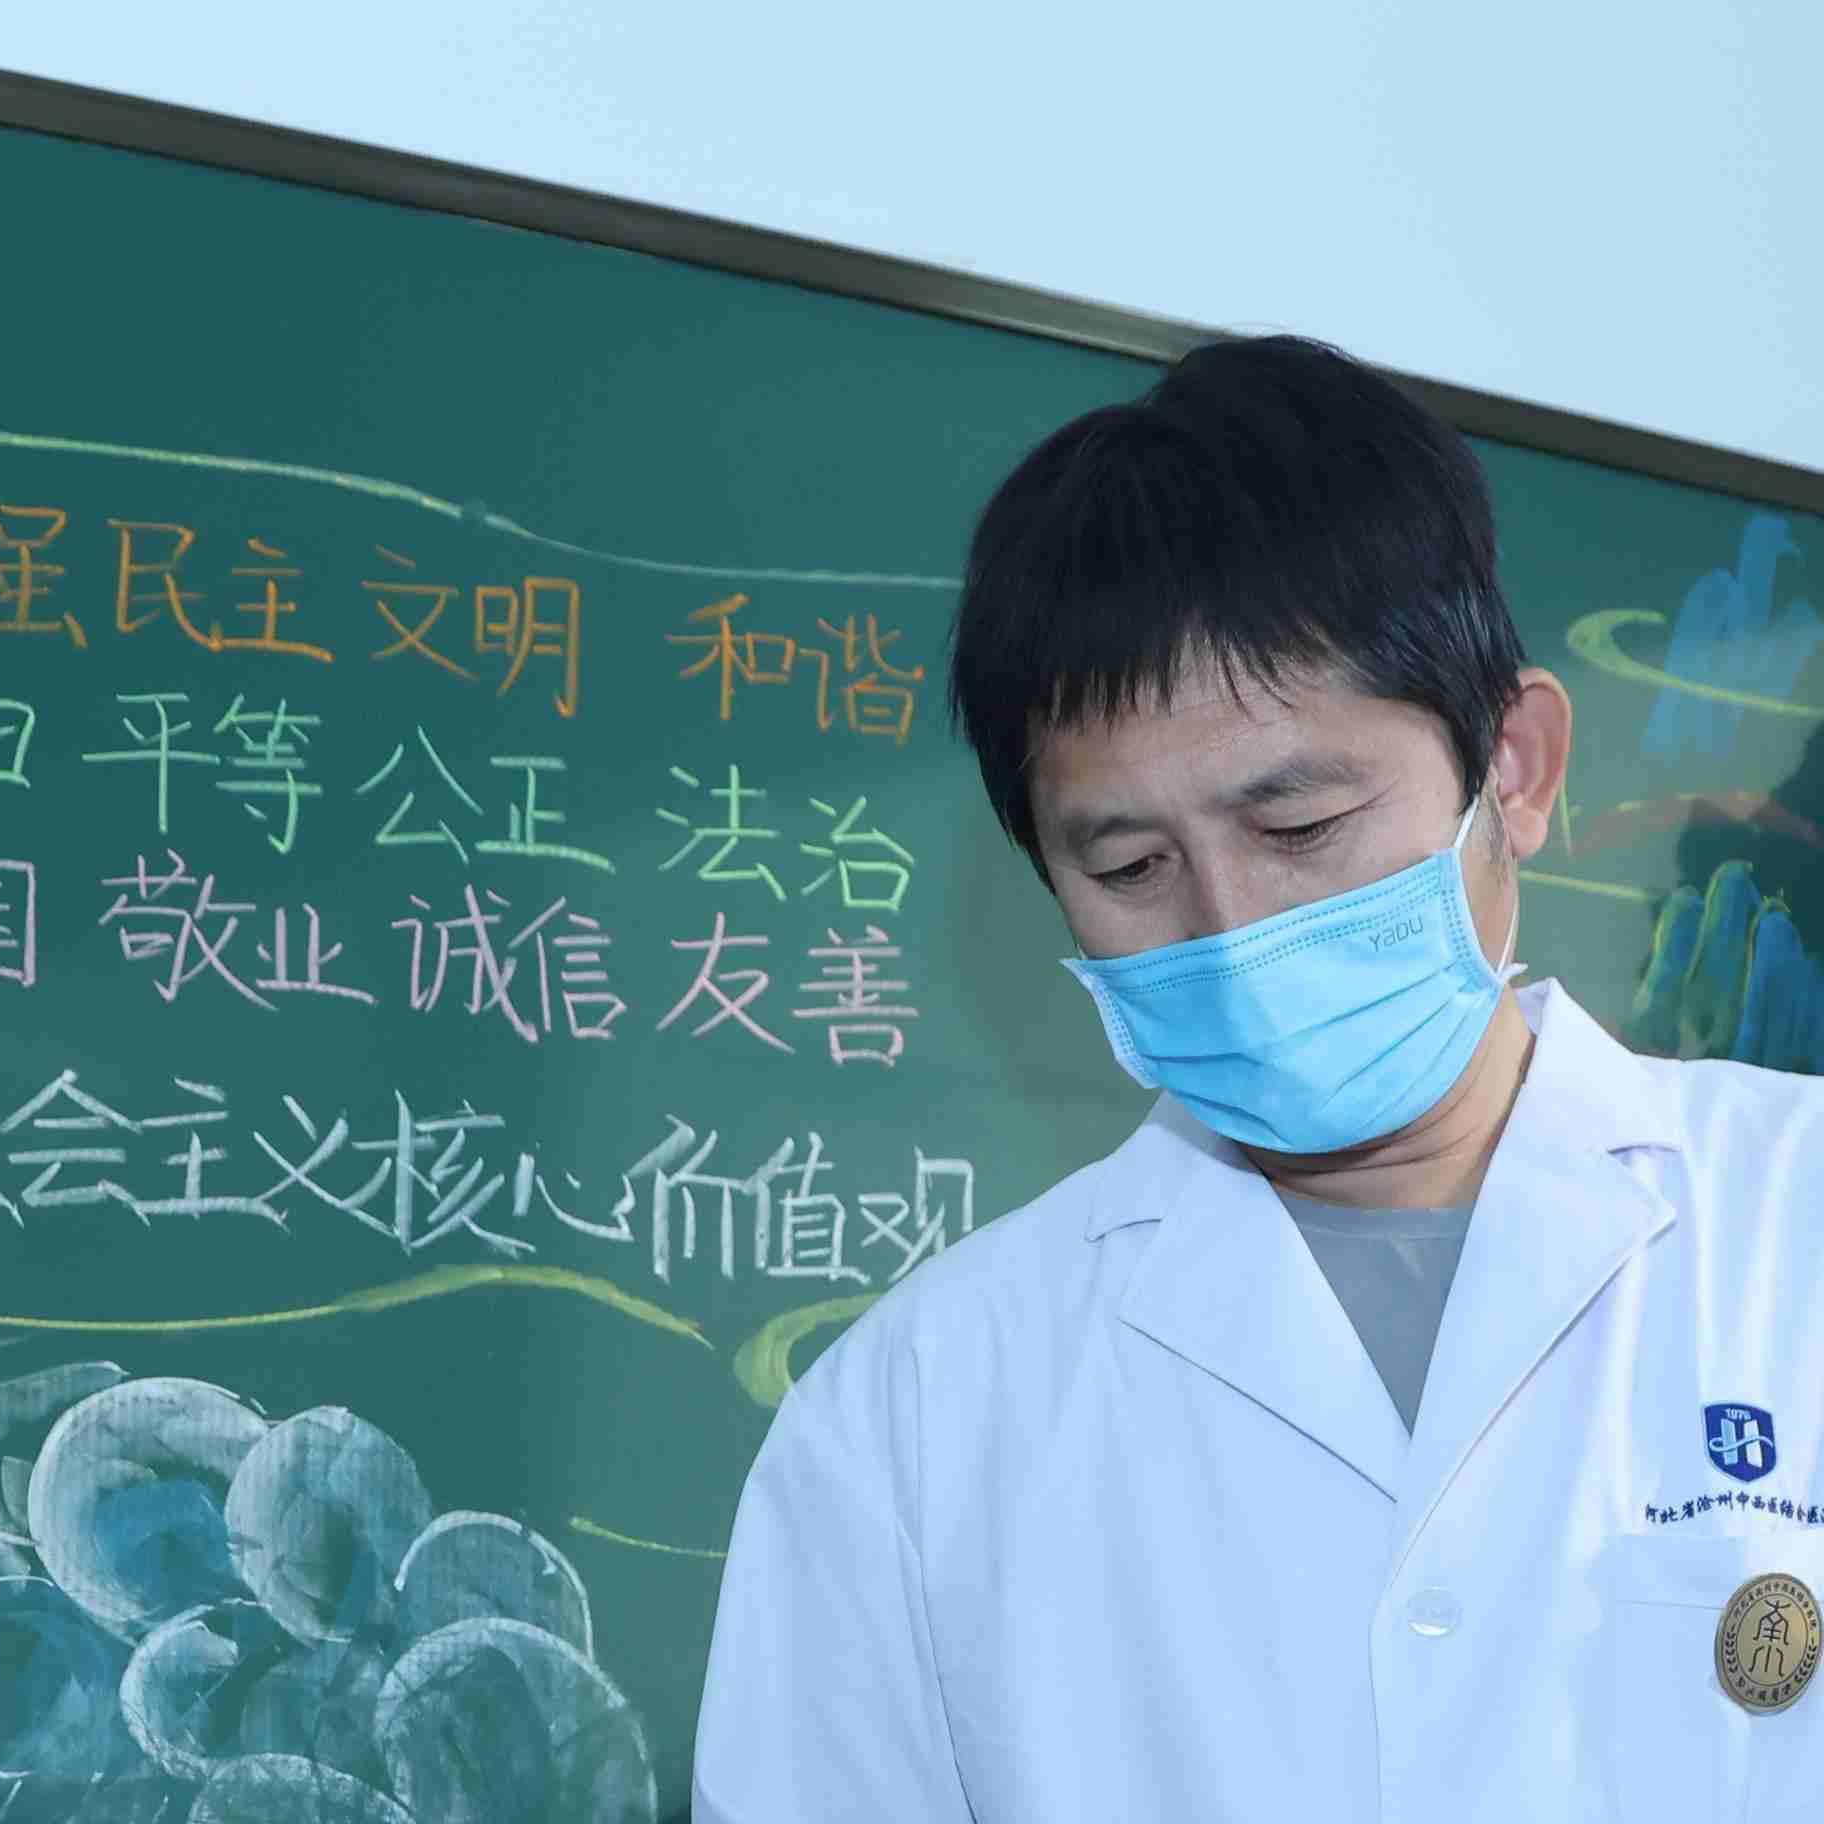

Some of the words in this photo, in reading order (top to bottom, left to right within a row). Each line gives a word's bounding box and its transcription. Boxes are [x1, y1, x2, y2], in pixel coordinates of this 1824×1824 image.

[108, 518, 335, 663] 民主
[360, 545, 580, 717] 文明
[664, 593, 926, 747] 和谐
[82, 693, 323, 854] 平等
[355, 724, 616, 875] 公正
[656, 764, 918, 911] 法治
[98, 847, 379, 1012] 敬业
[390, 883, 628, 1044] 诚信
[655, 911, 920, 1068] 友善
